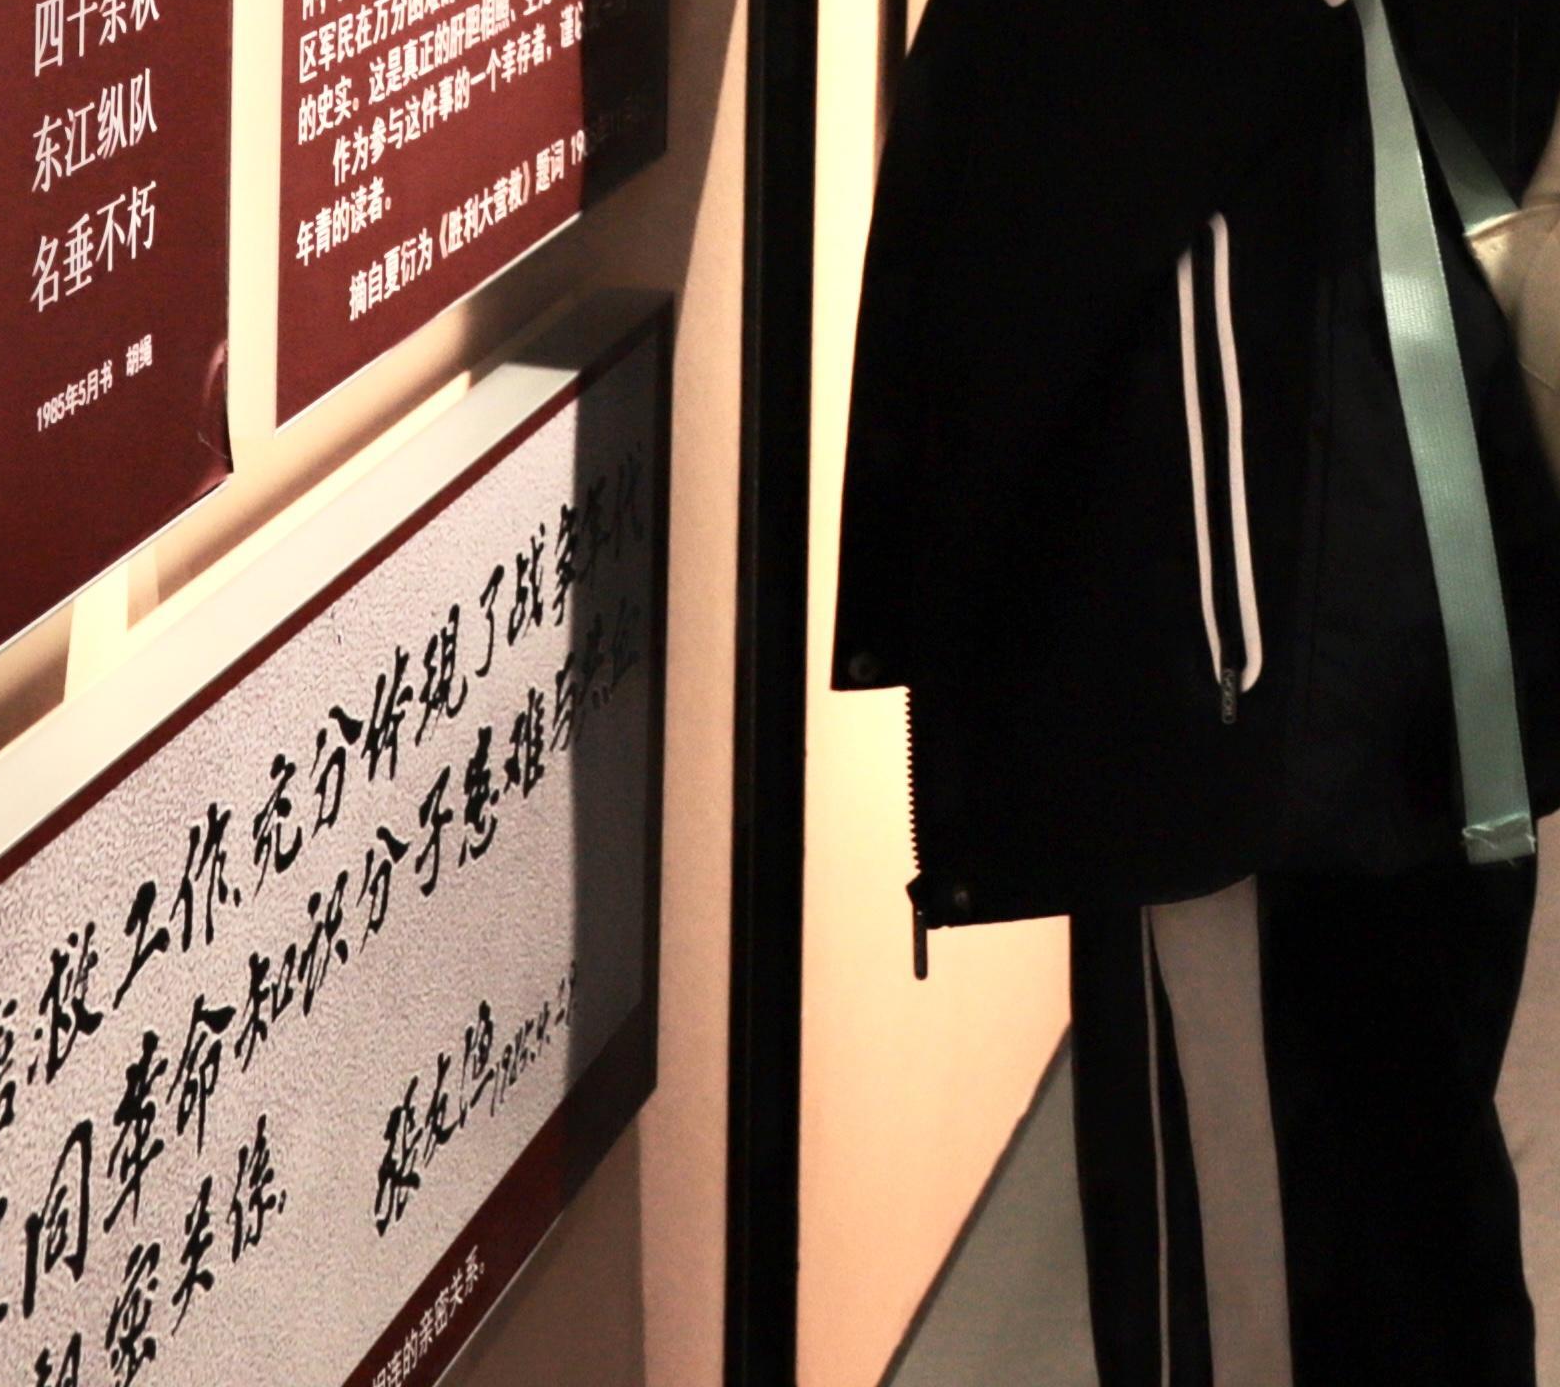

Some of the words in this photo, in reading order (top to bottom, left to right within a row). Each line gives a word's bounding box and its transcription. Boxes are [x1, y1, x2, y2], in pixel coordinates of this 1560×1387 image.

[32, 68, 157, 193] 东江纵队
[30, 180, 156, 312] 名垂不朽
[296, 178, 391, 265] 年青的读者。
[37, 359, 113, 432] 1985年5月书
[125, 334, 152, 378] 胡绳
